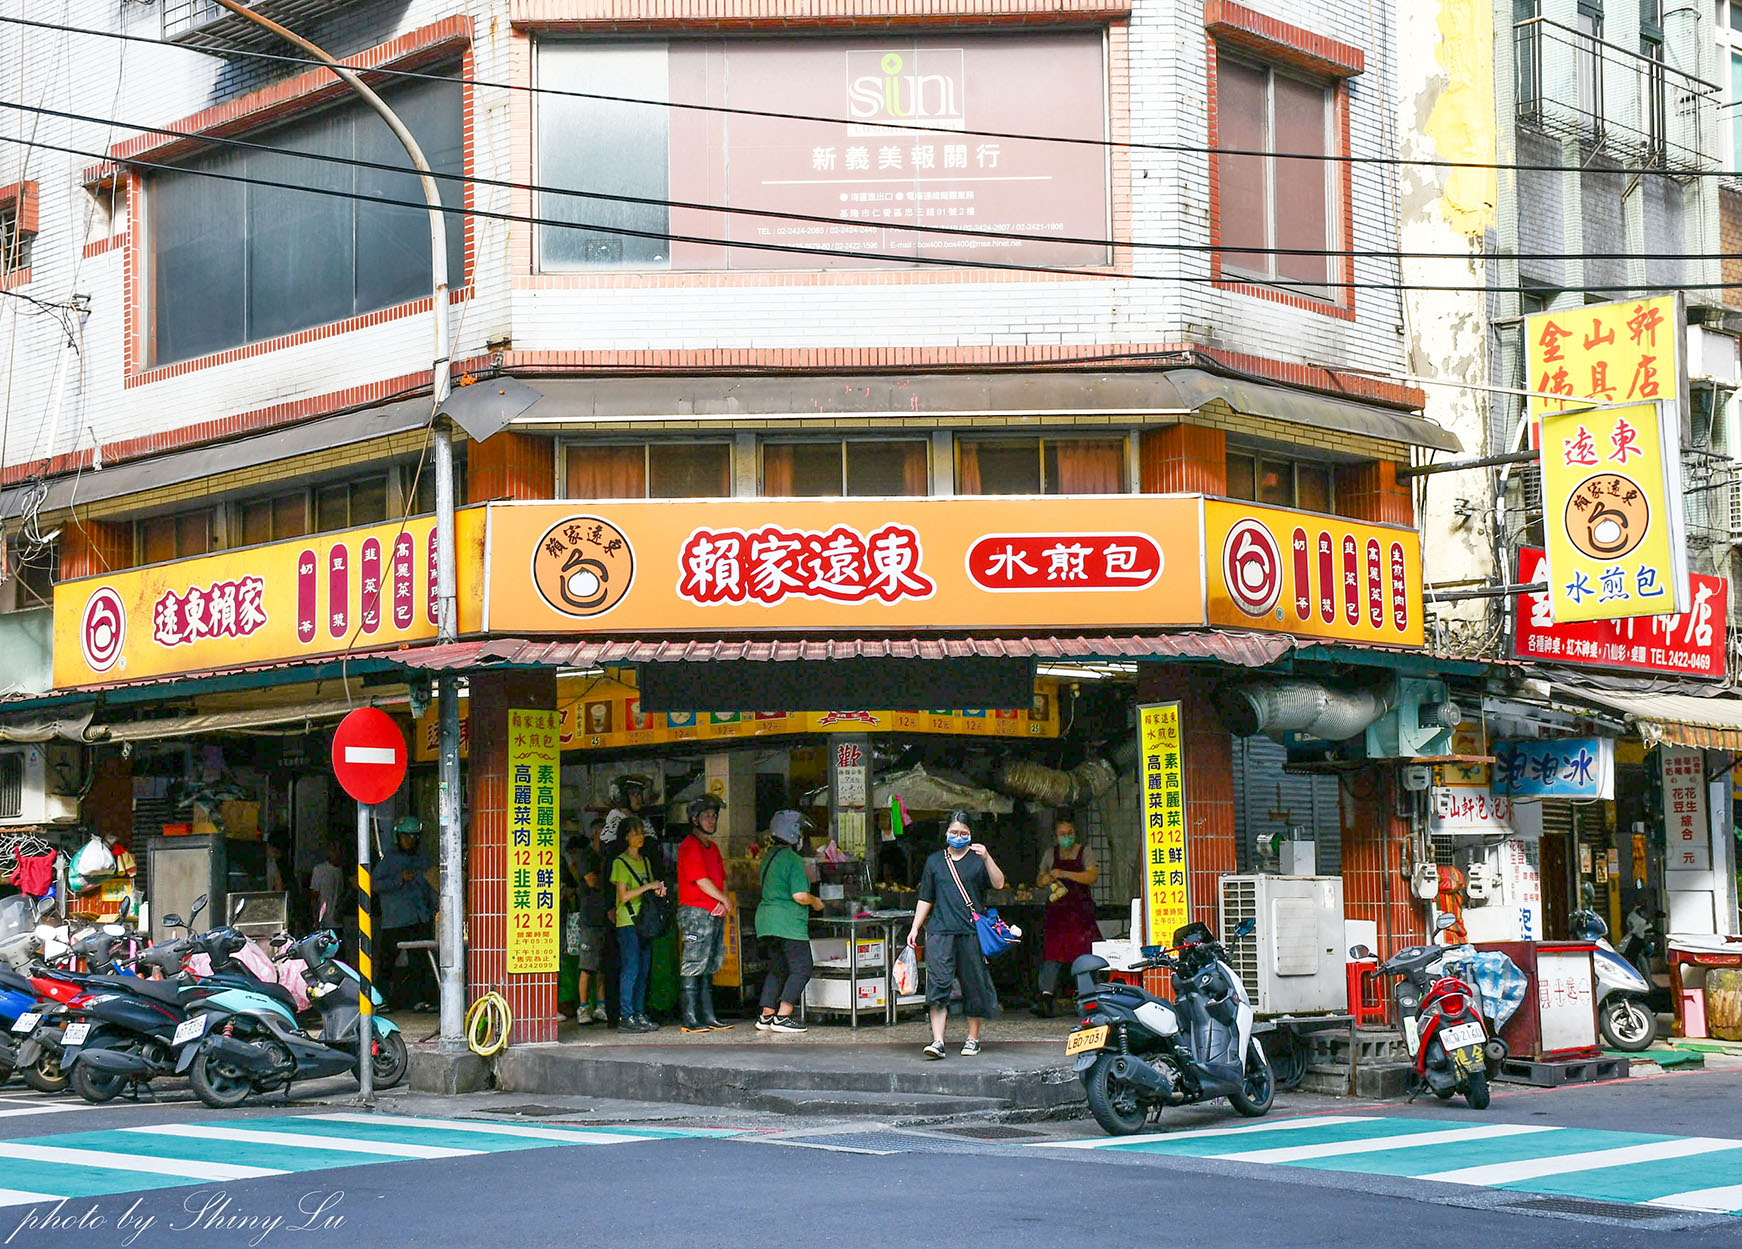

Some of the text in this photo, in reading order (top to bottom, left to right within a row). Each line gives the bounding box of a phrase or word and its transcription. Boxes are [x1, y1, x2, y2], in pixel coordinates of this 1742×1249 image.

[812, 144, 1001, 171] 新義美報關行
[1538, 303, 1665, 364] 金山軒
[1537, 354, 1660, 411] 佛具店
[1563, 418, 1643, 466] 遠東
[1573, 479, 1638, 512] 賴家遠東
[545, 524, 622, 559] 賴家遠東
[985, 543, 1153, 582] 水煎包
[684, 533, 934, 599] 賴家遠東
[1564, 564, 1664, 604] 水煎包
[155, 579, 267, 645] 遠東賴家
[1650, 647, 1668, 666] TEL
[1668, 651, 1711, 671] 2422-0469
[514, 732, 555, 749] 水煎包
[1496, 746, 1595, 789] 泡泡冰
[513, 764, 531, 929] 高麗菜肉 12 韭菜 12
[537, 764, 555, 929] 素高麗菜 12 鮮肉 12
[1147, 754, 1167, 905] 高麗菜肉 12 韭菜 12
[1164, 753, 1185, 904] 素高麗菜 12 鮮肉 12
